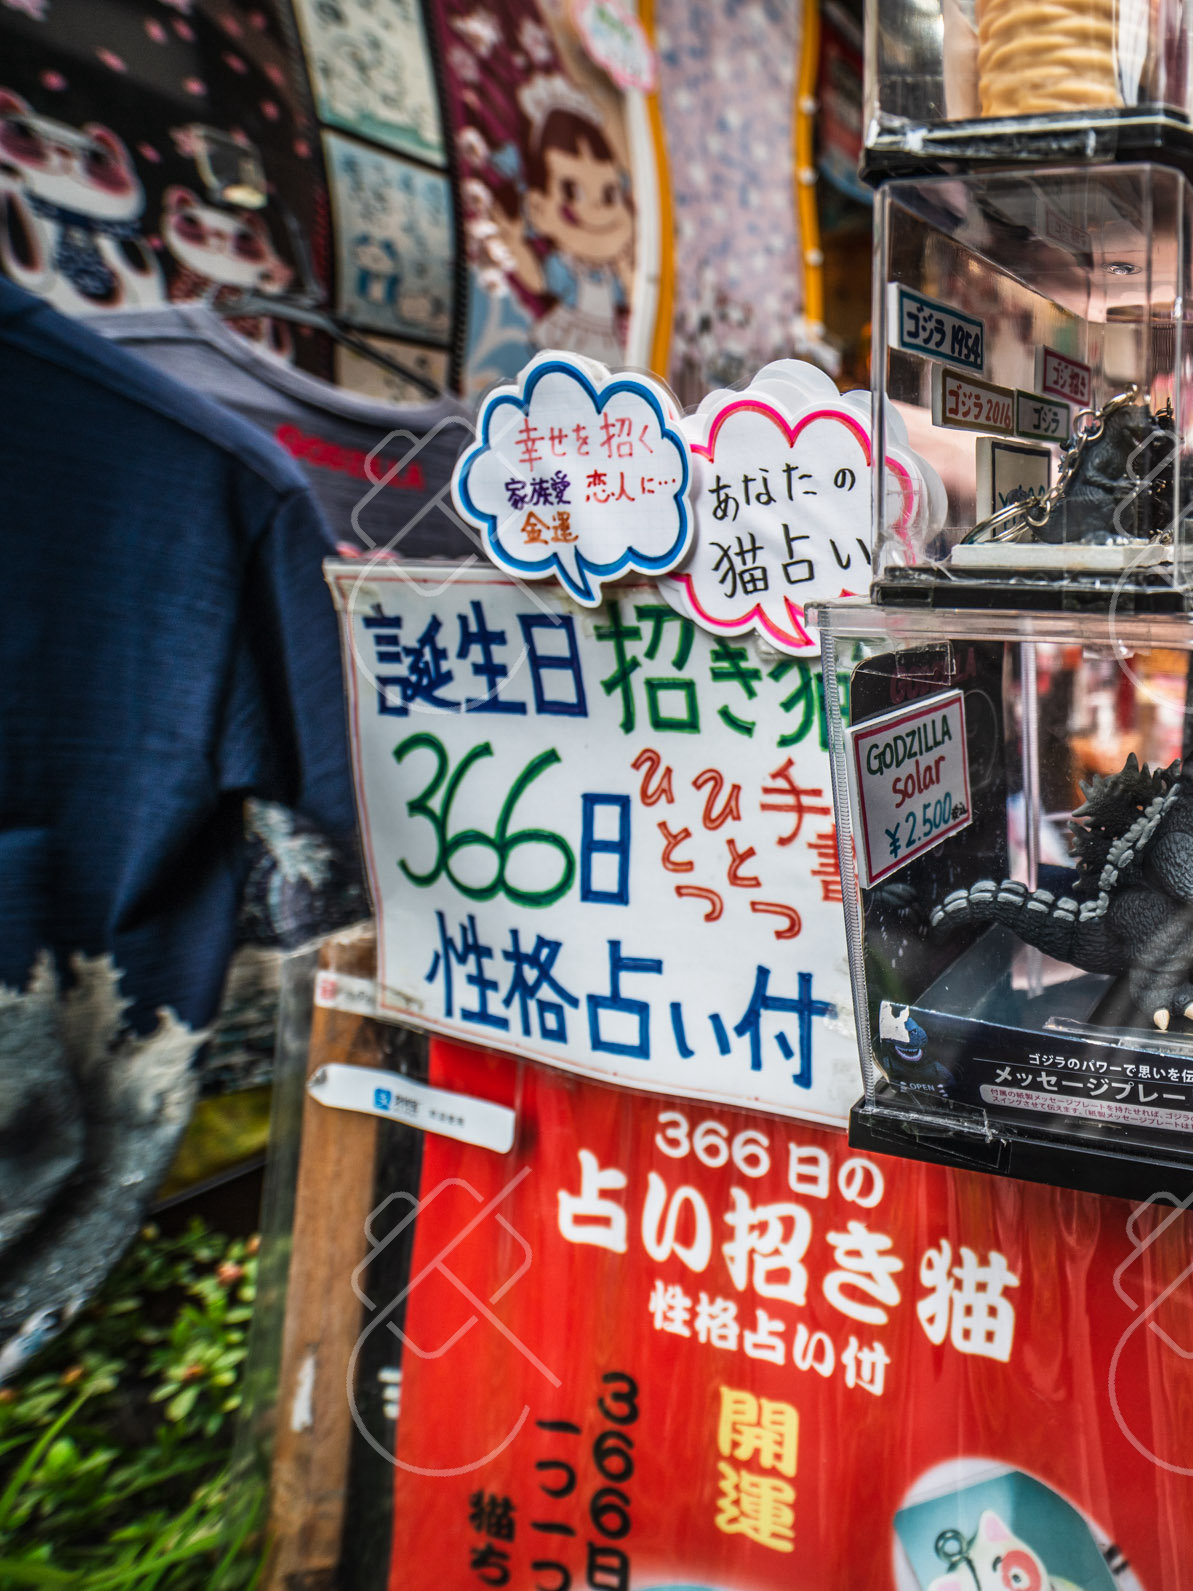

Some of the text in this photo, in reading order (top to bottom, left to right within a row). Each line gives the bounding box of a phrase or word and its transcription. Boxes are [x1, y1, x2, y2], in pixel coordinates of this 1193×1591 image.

[906, 304, 981, 365] ゴジラ 1954
[514, 411, 654, 472] 幸せを招く
[947, 383, 1011, 430] ゴジラ 2016
[1032, 405, 1061, 434] ゴジラ
[520, 510, 579, 545] 金運
[708, 462, 856, 522] あなたの
[709, 523, 871, 600] 猫占い
[362, 600, 589, 718] 誕生日
[865, 713, 953, 776] GODZILLA
[891, 754, 946, 809] solar
[630, 747, 724, 923] ひとつ
[691, 767, 803, 941] ひとつ
[425, 910, 838, 1090] 性格占い付
[909, 1082, 936, 1092] OPEN
[655, 1111, 885, 1208] 366日の
[557, 1149, 1021, 1363] 占い招き猫
[648, 1279, 891, 1396] 性格占い付
[586, 1371, 640, 1591] 366日
[713, 1384, 800, 1554] 開運
